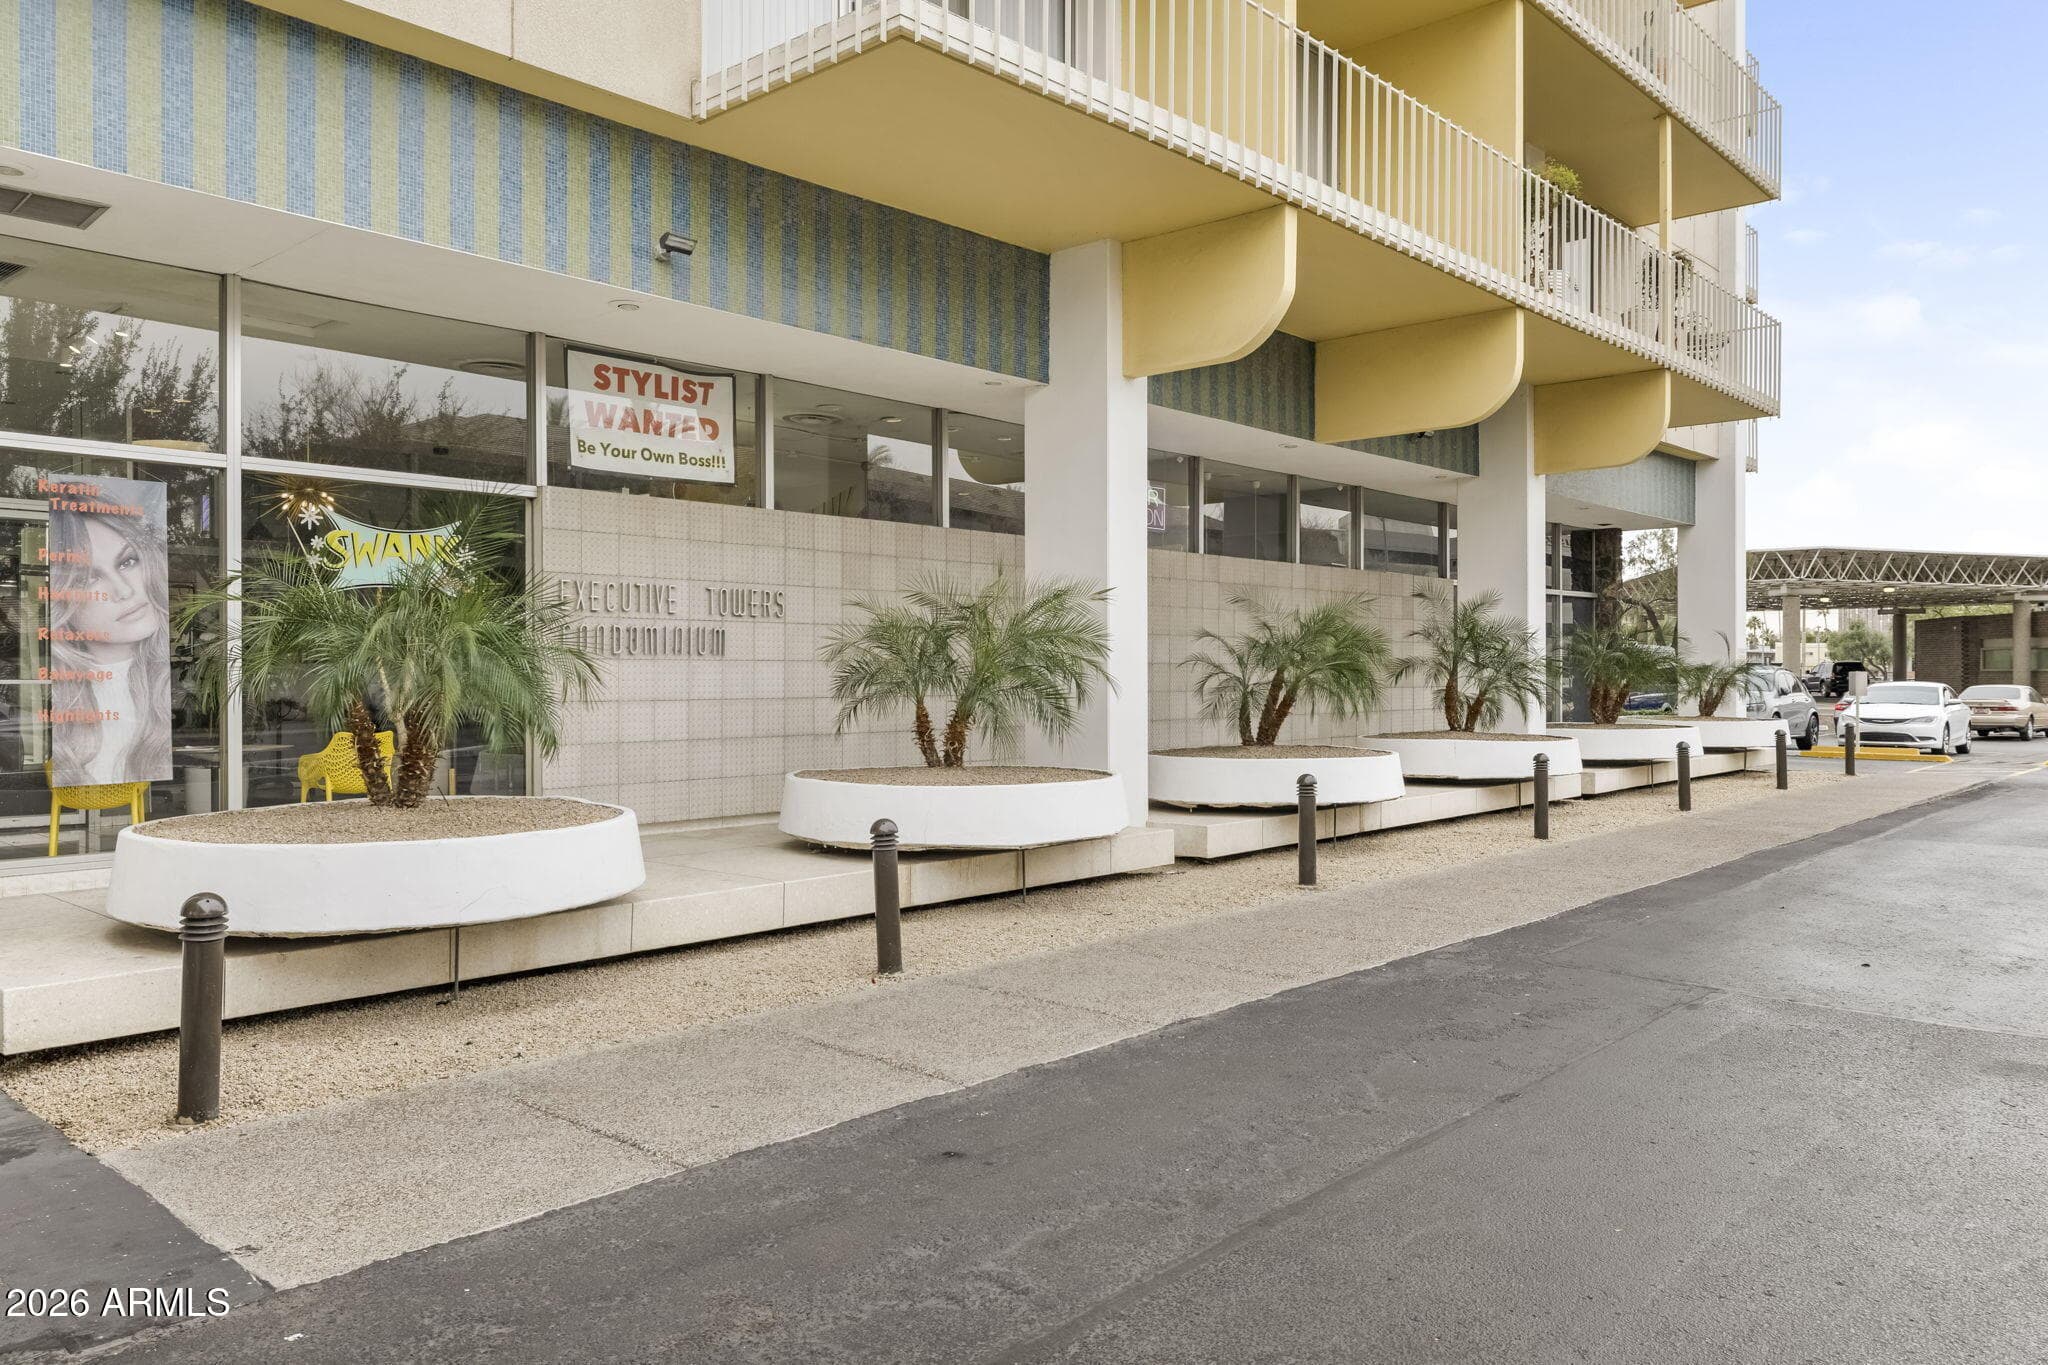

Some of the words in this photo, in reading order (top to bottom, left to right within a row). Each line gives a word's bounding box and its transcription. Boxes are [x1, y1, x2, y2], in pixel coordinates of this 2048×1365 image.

[593, 363, 715, 406] STYLIST
[584, 399, 720, 442] WANTED
[577, 439, 596, 455] Be
[600, 442, 637, 460] Your
[640, 447, 675, 464] Own
[679, 452, 727, 469] Boss!!!
[38, 478, 101, 497] Keratin
[50, 497, 144, 516] Treatments
[559, 578, 677, 614] EXECUTIVE
[705, 586, 785, 618] TOWERS
